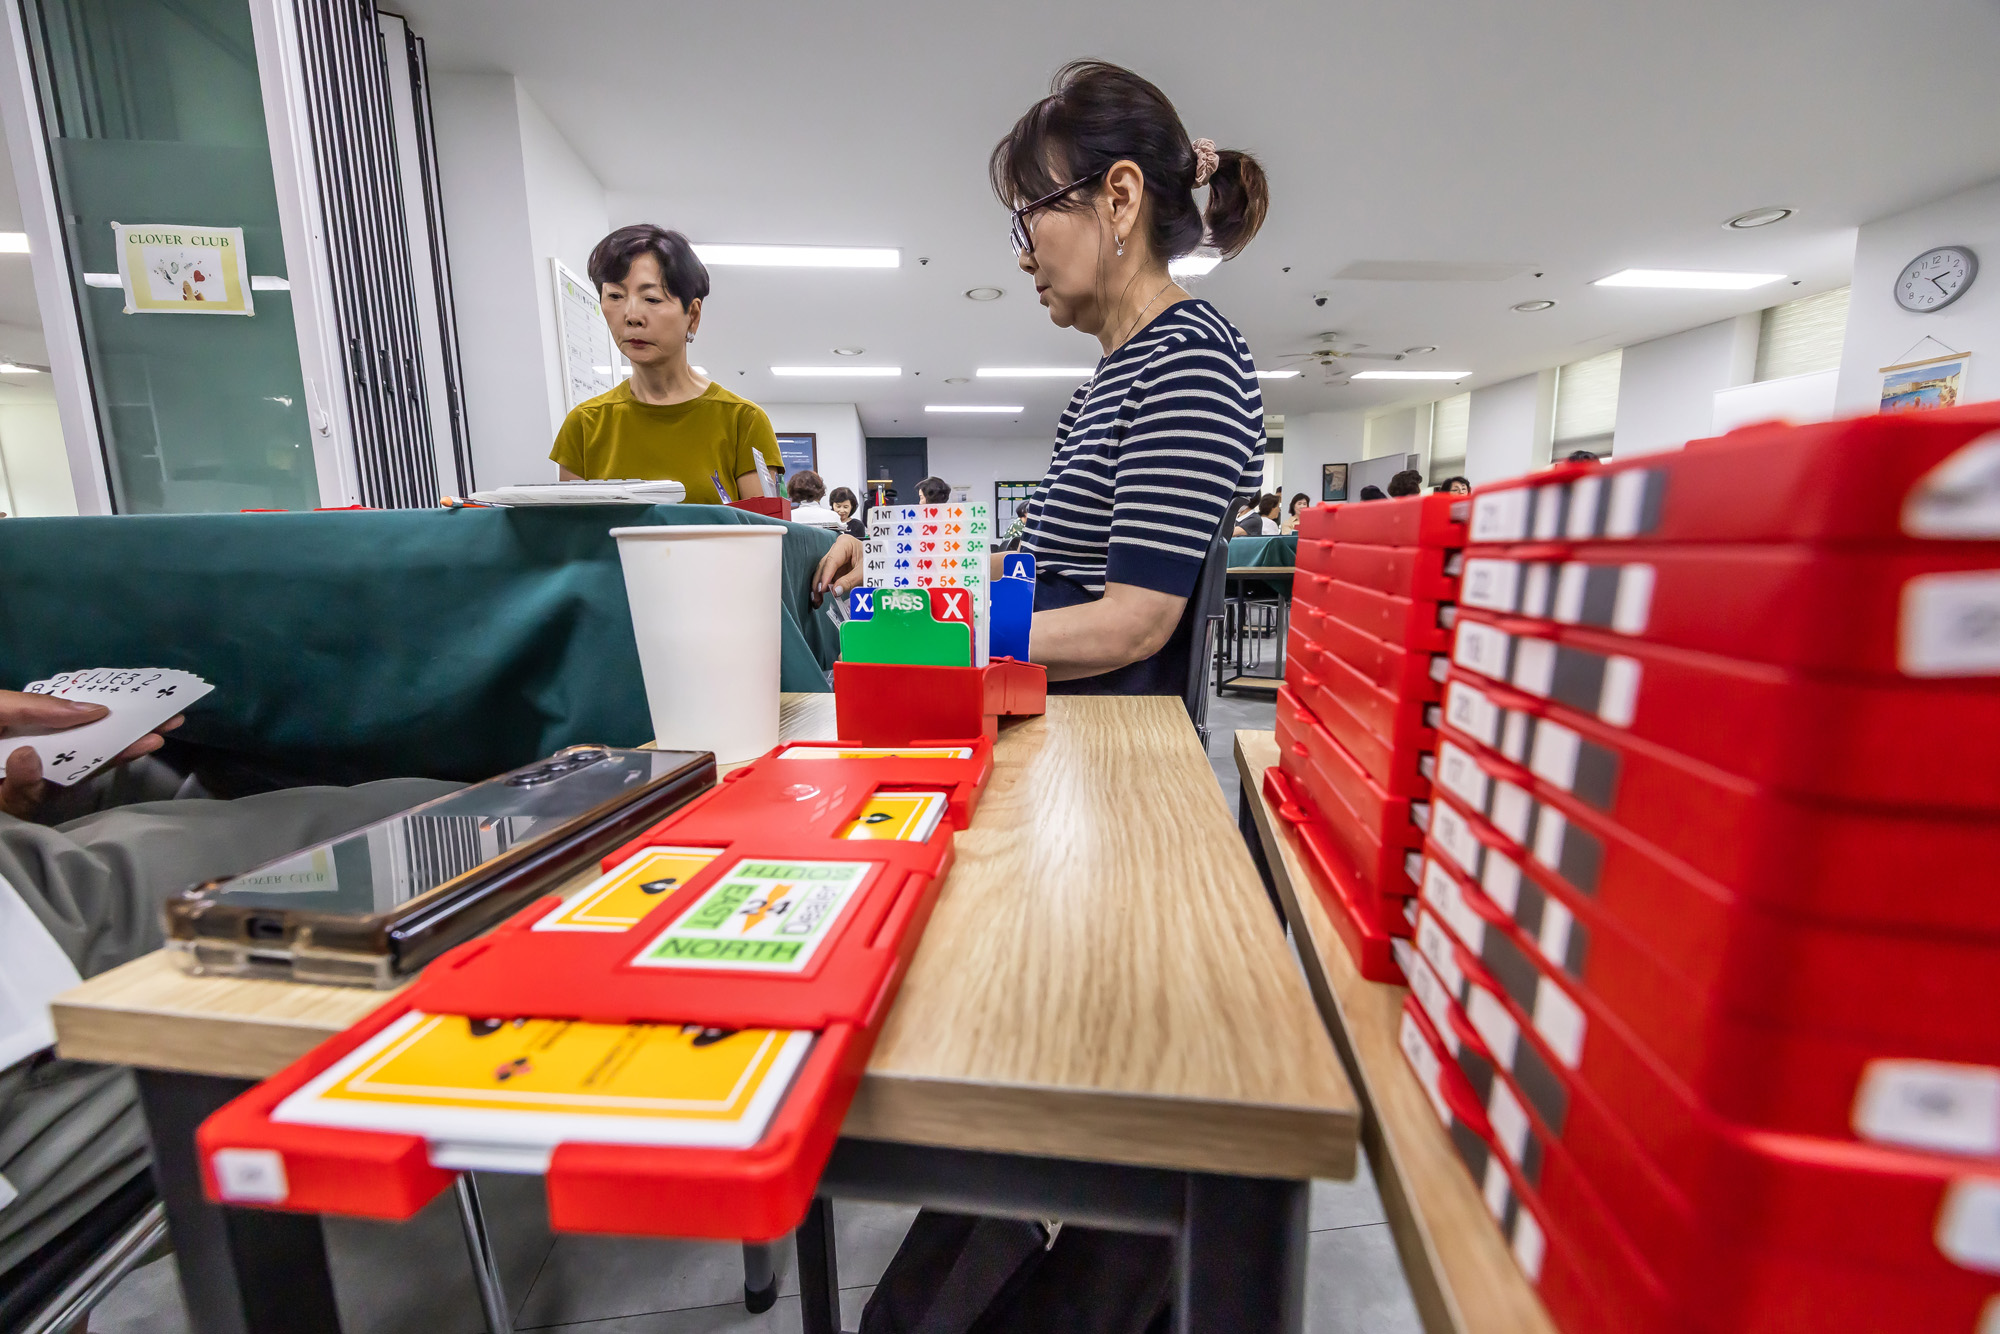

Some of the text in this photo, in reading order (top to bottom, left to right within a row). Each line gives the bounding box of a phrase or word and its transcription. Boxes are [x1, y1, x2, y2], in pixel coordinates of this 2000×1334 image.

[129, 234, 229, 247] CLOVER CLUB
[1933, 255, 1942, 264] 12
[1953, 259, 1960, 268] 2
[1921, 262, 1928, 270] 11
[1911, 271, 1920, 279] 10
[1957, 270, 1963, 278] 3
[1905, 282, 1912, 290] 9
[1951, 281, 1957, 289] 4
[1909, 292, 1914, 300] 8
[1918, 295, 1924, 304] 7
[1927, 296, 1934, 304] 6
[1012, 561, 1027, 577] A
[882, 595, 924, 611] PASS
[942, 593, 964, 619] X
[52, 676, 69, 687] 2
[142, 674, 162, 686] 2
[741, 864, 855, 881] SOUTH
[695, 884, 755, 929] EAST
[658, 937, 806, 961] NORTH
